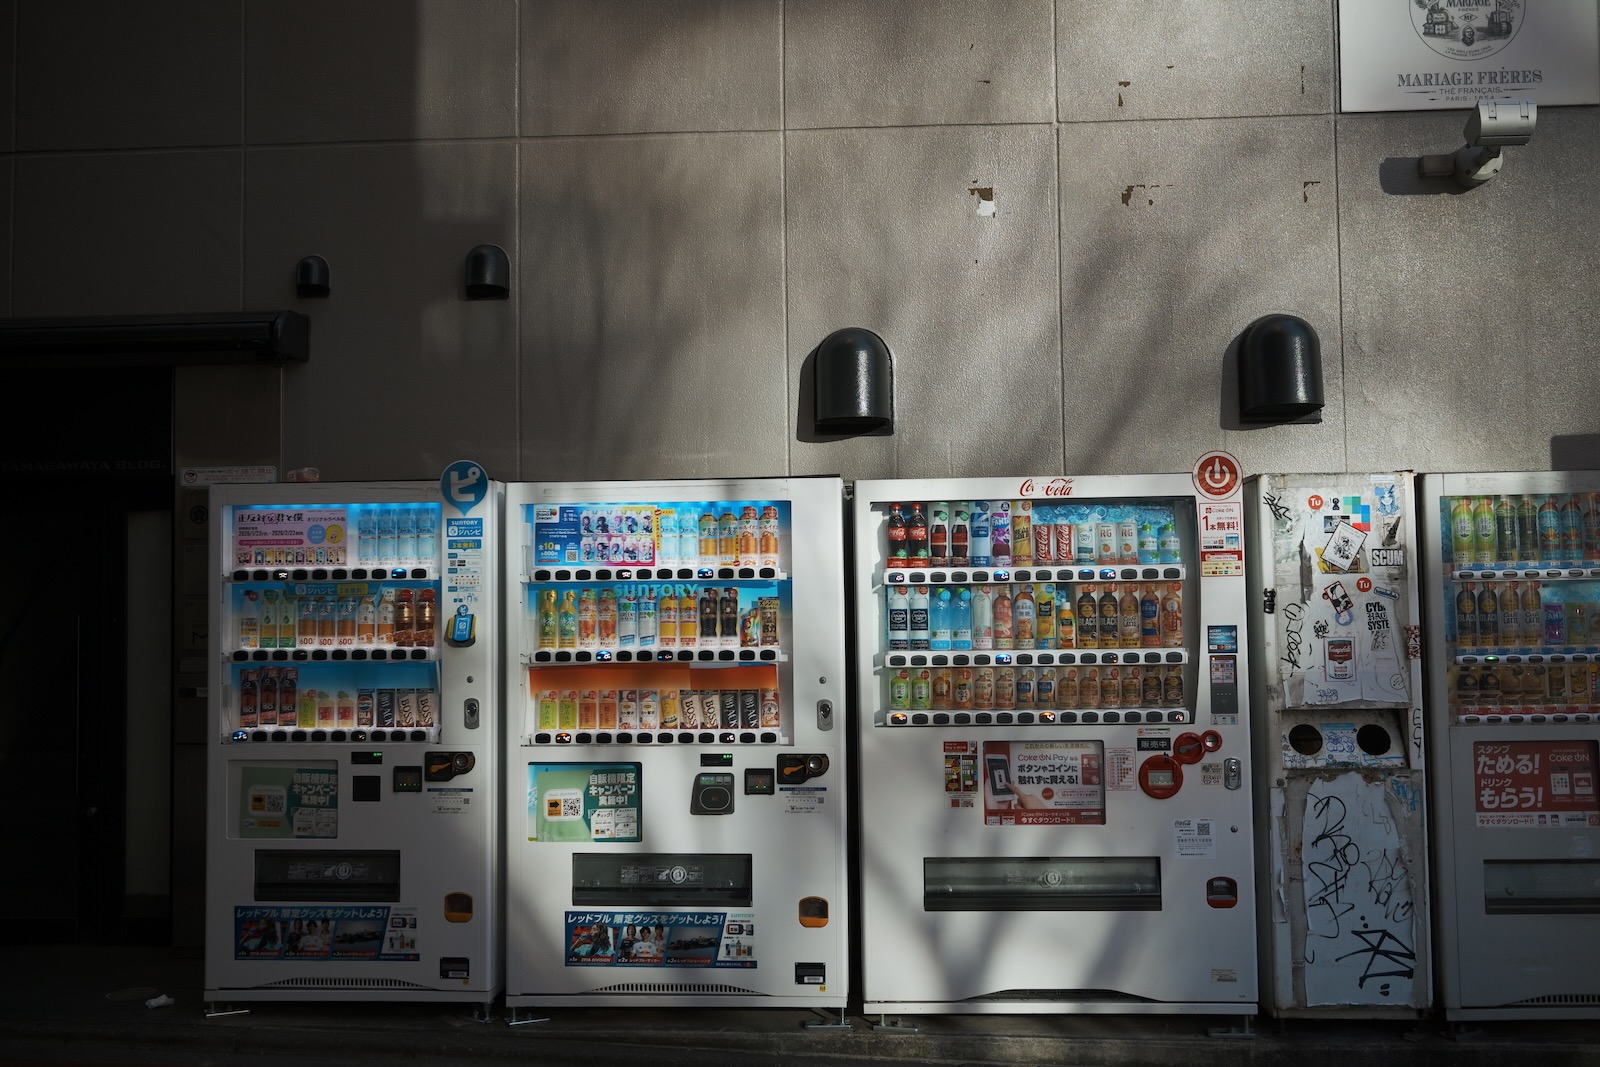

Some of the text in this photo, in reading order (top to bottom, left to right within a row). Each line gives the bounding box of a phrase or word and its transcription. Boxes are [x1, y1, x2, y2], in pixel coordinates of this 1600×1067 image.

[1397, 67, 1543, 87] MARIAGE FRÈRES
[1439, 86, 1456, 95] THÉ
[449, 466, 481, 502] ピ
[1310, 498, 1322, 506] Tu
[238, 512, 304, 525] 正反対な君と僕
[1202, 516, 1239, 531] 1本無料!
[1100, 530, 1112, 538] RG
[1122, 530, 1133, 538] RG
[1372, 550, 1404, 566] SCUM
[1359, 580, 1370, 588] Tu
[613, 583, 698, 597] SUNTORY
[319, 638, 332, 646] 600
[338, 638, 352, 646] 600
[404, 698, 414, 726] BOSS
[420, 698, 432, 725] BOSS
[684, 699, 697, 726] BOSS
[704, 699, 717, 726] BOSS
[1140, 740, 1168, 749] 販売中
[1478, 744, 1511, 754] スタンプ
[1018, 754, 1038, 762] Coke
[1039, 753, 1052, 761] ON
[1052, 754, 1069, 763] Pay
[1549, 752, 1590, 762] Coke ON
[1018, 764, 1078, 773] ボタンやコインに
[1476, 754, 1541, 775] ためる!
[293, 773, 338, 784] 自販機限定
[590, 772, 636, 785] 自販機限定
[1018, 775, 1079, 786] 触れずに買える!
[1480, 778, 1512, 787] ドリンク
[292, 784, 338, 795] キャンペーン
[588, 784, 636, 796] キャンペーン
[300, 794, 331, 806] 実施中!
[598, 795, 628, 806] 実施中!
[1480, 786, 1544, 810] もらう!
[236, 908, 388, 920] レッドブル 限定グッズをゲットしよう!
[568, 914, 724, 925] レッドブル 限定グッズをゲットしよう!
